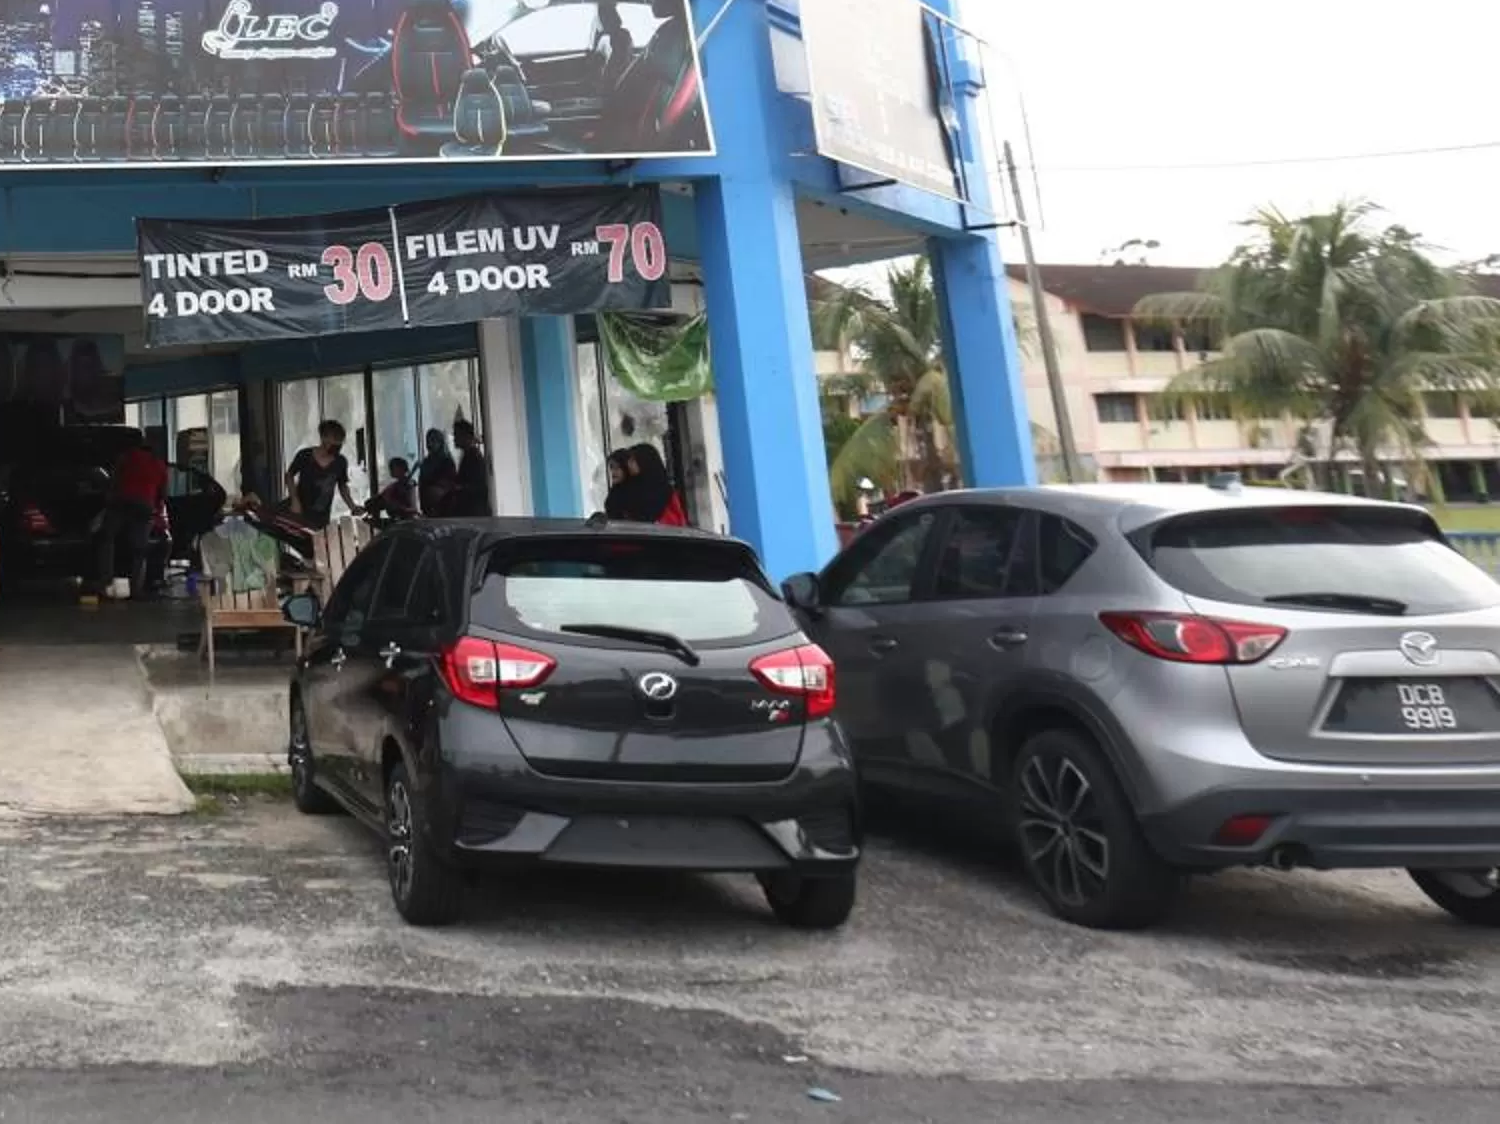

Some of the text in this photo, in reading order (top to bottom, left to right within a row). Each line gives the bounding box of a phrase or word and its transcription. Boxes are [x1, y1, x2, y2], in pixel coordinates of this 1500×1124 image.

[405, 221, 665, 283] FILEM UV RM 70
[143, 243, 393, 304] TINTED RM 30
[426, 264, 551, 296] 4 DOOR
[147, 287, 275, 317] 4 DOOR
[1402, 707, 1457, 728] 9919
